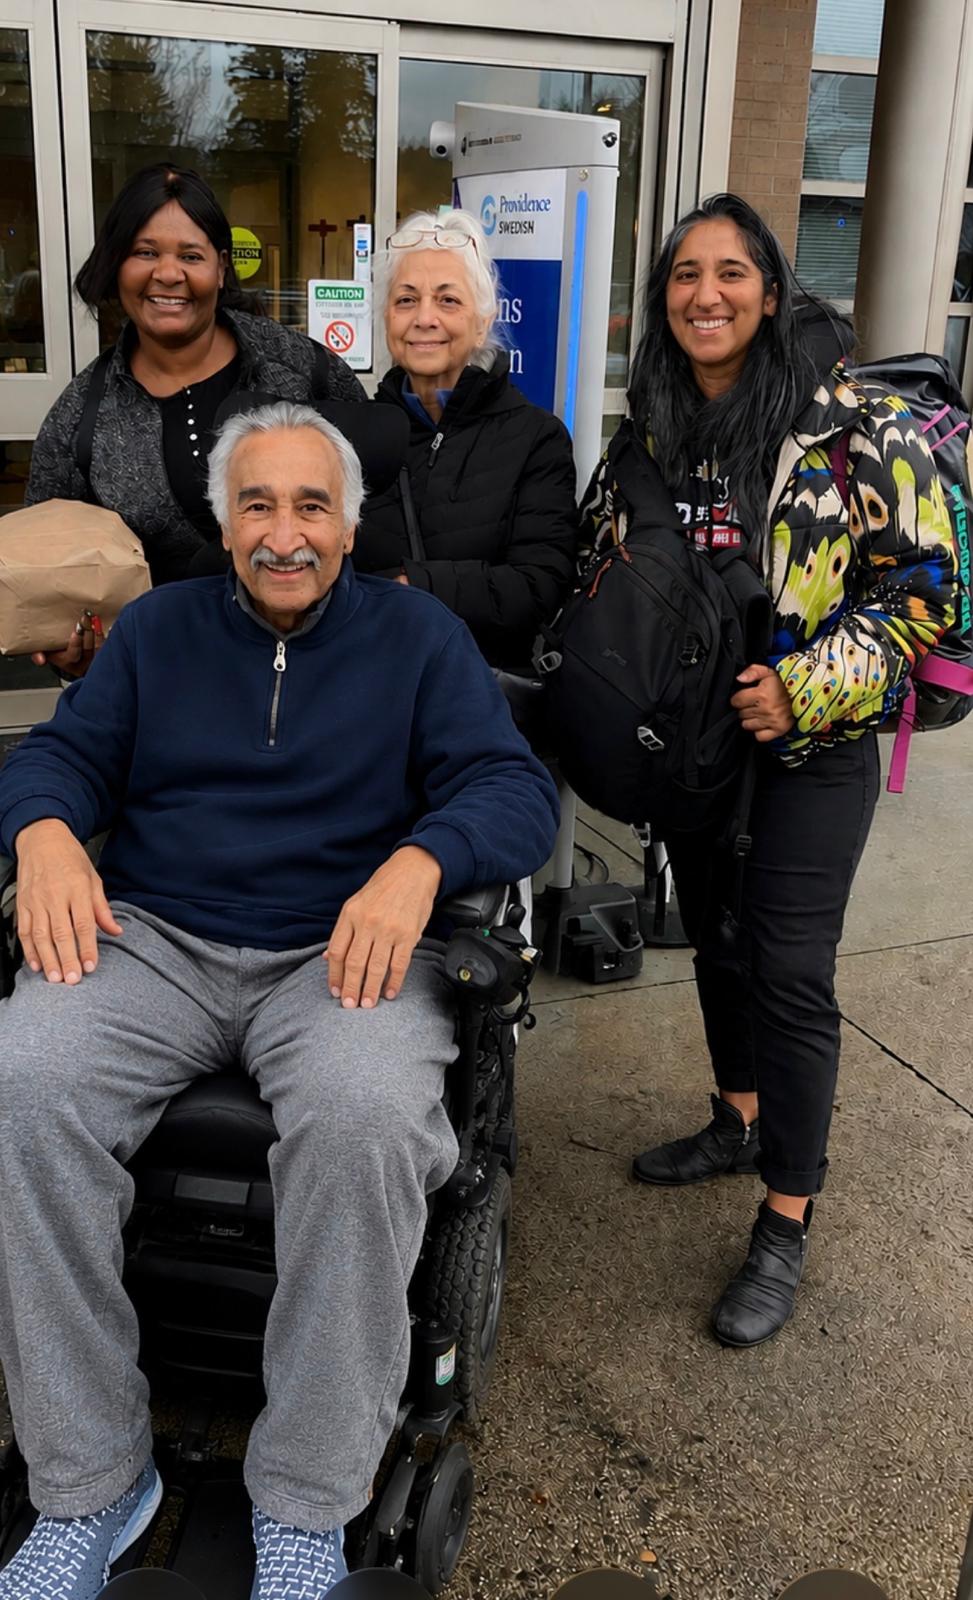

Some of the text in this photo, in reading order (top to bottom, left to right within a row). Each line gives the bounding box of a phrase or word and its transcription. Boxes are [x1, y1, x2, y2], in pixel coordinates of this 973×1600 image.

[500, 193, 551, 213] Providence
[316, 288, 363, 299] CAUTION
[497, 298, 522, 323] ns
